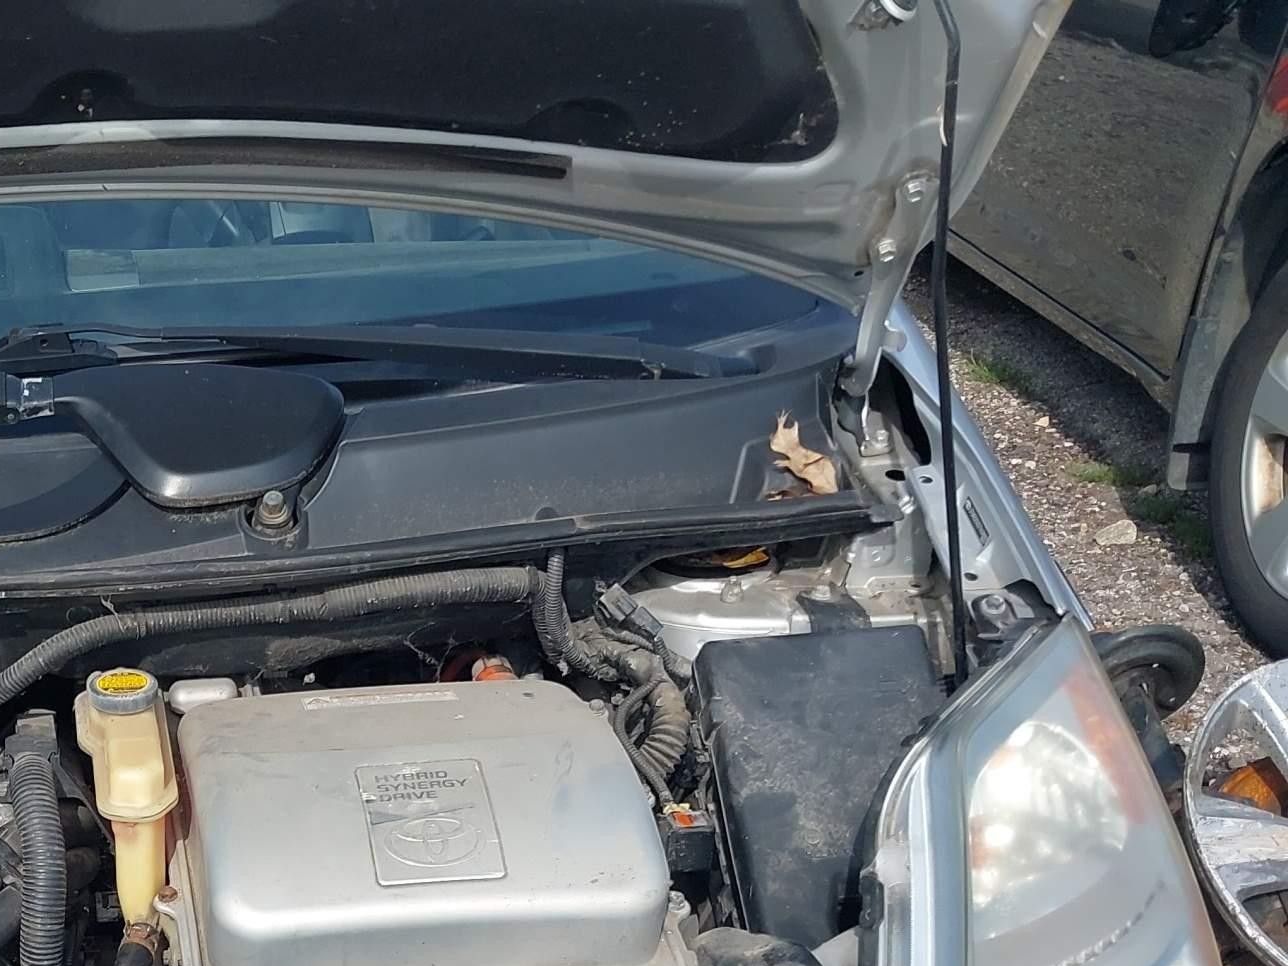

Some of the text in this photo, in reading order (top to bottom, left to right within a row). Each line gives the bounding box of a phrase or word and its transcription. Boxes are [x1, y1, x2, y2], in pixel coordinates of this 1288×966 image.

[375, 771, 447, 783] HYBRID
[376, 779, 467, 792] SYNERGY
[379, 790, 439, 802] DRIVE
